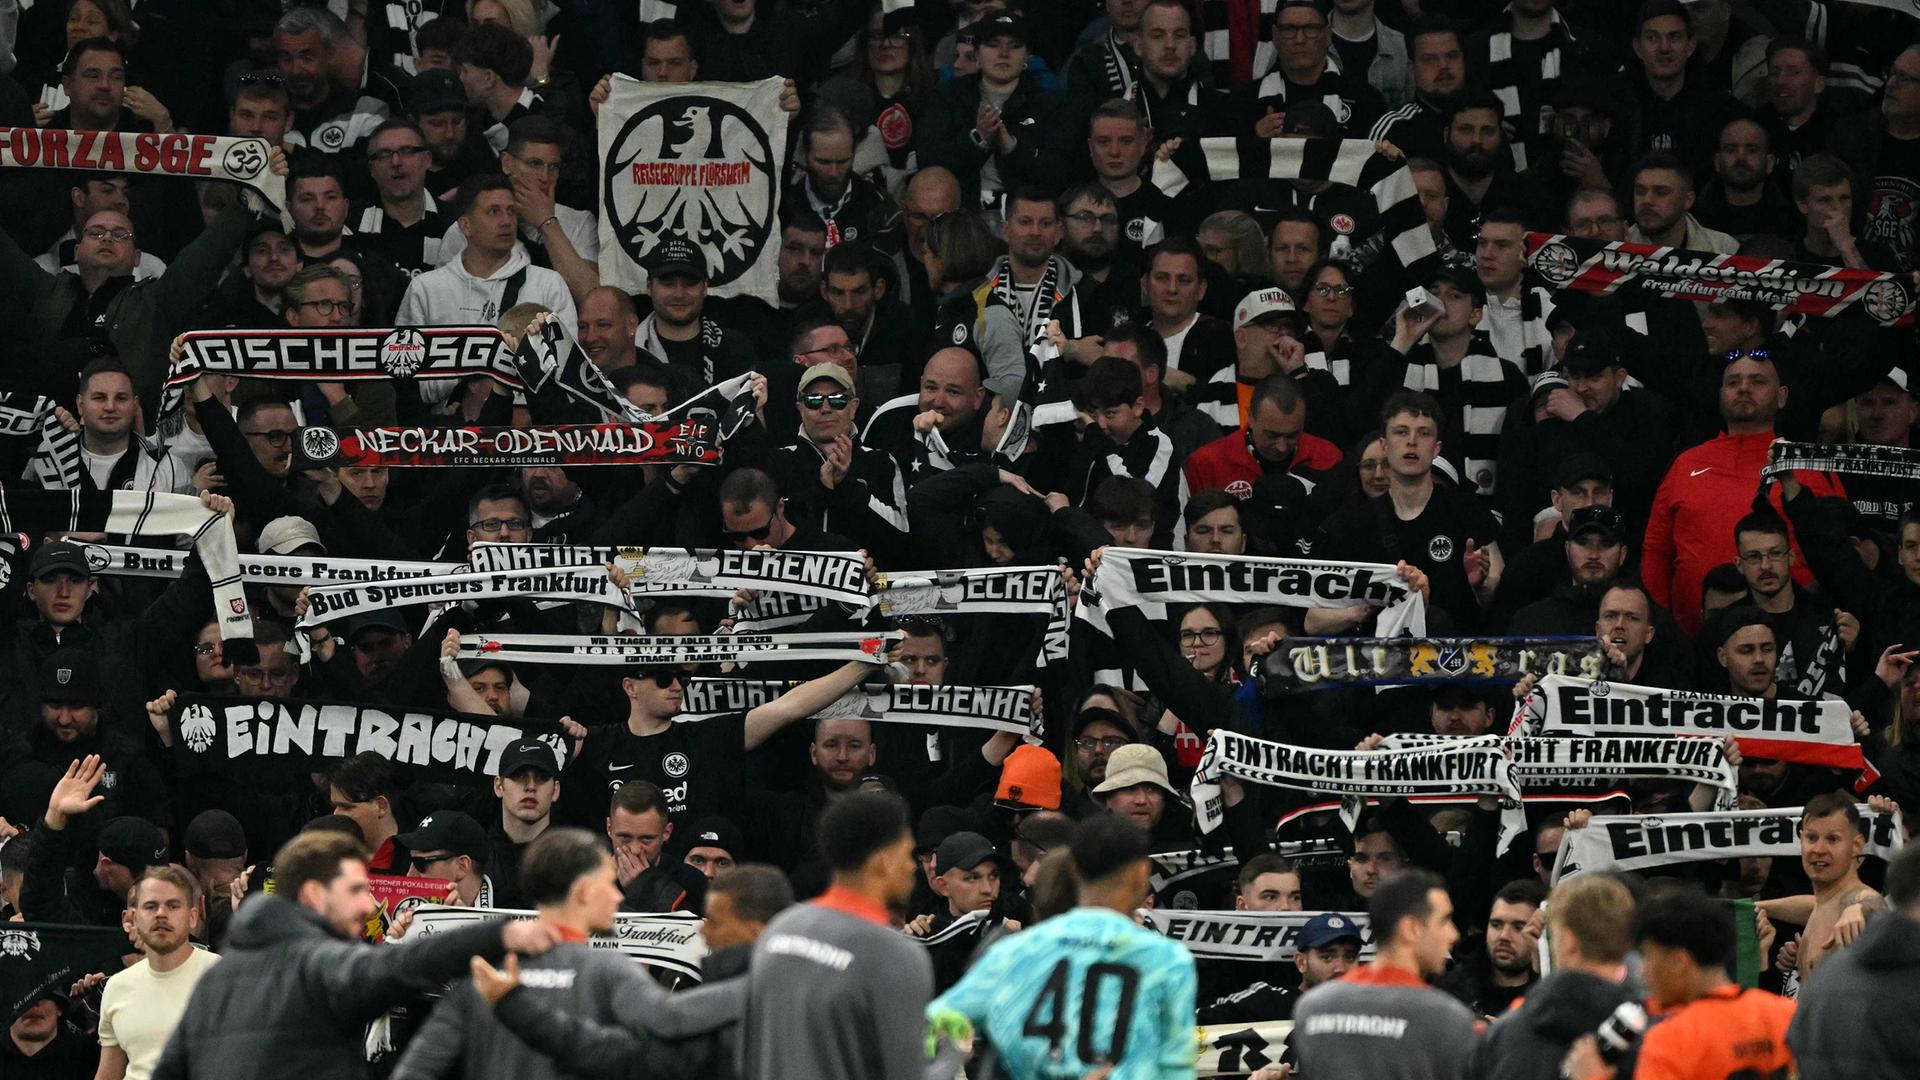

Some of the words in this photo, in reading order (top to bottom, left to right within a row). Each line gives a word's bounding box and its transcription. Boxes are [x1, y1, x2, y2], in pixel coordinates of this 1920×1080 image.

[135, 133, 216, 175] SGE
[1601, 248, 1847, 298] Waldstadion
[429, 336, 517, 377] SGE
[355, 424, 654, 455] NECKAR-ODENWALD
[124, 552, 173, 571] Bud
[309, 588, 359, 617] Bud
[367, 576, 483, 607] Spencers
[491, 571, 609, 596] Frankfurt
[590, 637, 609, 645] WIR
[613, 637, 651, 645] TRAGEN
[656, 637, 675, 645] DEN
[681, 637, 711, 645] ADLER
[737, 636, 773, 644] HERZEN
[625, 654, 676, 663] EINTRACHT
[684, 652, 738, 662] FRANKFURT
[681, 680, 783, 712] KFURT
[1558, 686, 1823, 734] Eintracht
[1224, 736, 1352, 779] EINTRACHT
[1364, 751, 1503, 781] FRANKFURT
[1569, 739, 1724, 768] FRANKFURT
[1516, 767, 1538, 775] VER
[1543, 767, 1572, 775] LAND
[1577, 767, 1600, 775] AND
[1605, 767, 1626, 775] SEA
[1311, 781, 1337, 791] OVER
[1342, 783, 1367, 793] LAND
[1372, 785, 1392, 793] AND
[1396, 785, 1415, 794] SEA
[1606, 813, 1894, 861] Eintrat
[592, 941, 619, 949] MAIN
[615, 925, 697, 946] Frankfurt
[1022, 955, 1142, 1066] 40
